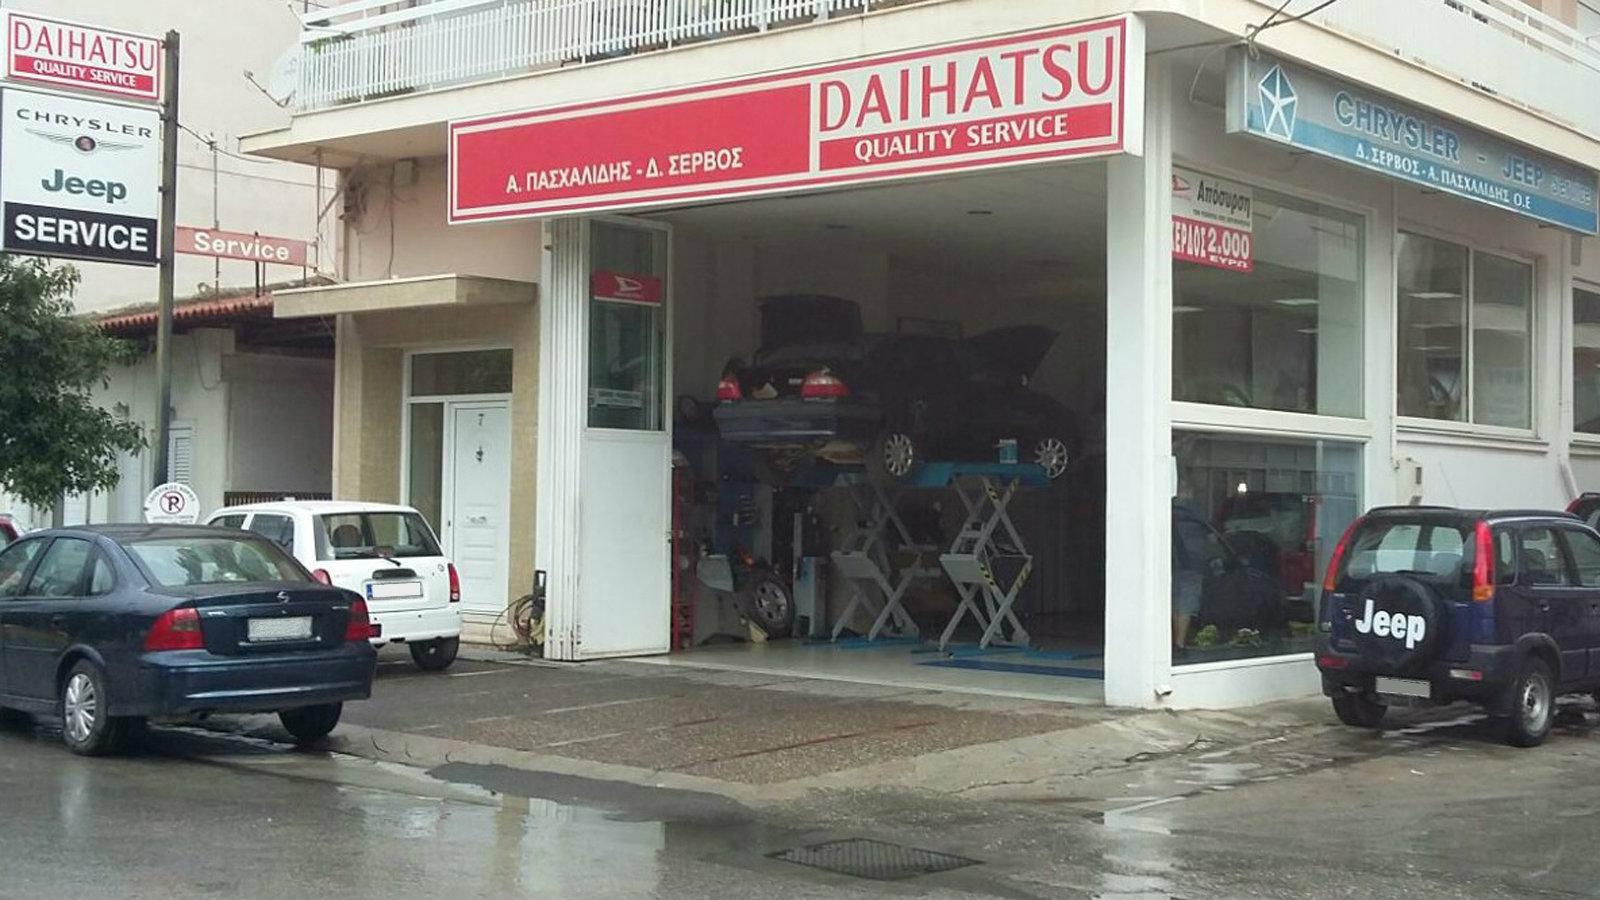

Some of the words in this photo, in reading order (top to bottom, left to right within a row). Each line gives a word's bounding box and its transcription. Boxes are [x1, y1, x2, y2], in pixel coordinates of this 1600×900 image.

[15, 21, 155, 71] DAIHATSU
[33, 59, 86, 79] QUALITY
[90, 69, 136, 87] SERVICE
[819, 36, 1113, 132] DAIHATSU
[16, 108, 151, 138] CHRYSLER
[854, 128, 956, 162] QUALITY
[967, 113, 1068, 147] SERVICE
[1334, 91, 1459, 162] CHRYSLER
[1501, 154, 1543, 190] JEEP
[41, 169, 127, 204] Jeep
[506, 174, 522, 193] Α.
[526, 160, 632, 191] ΠΑΣΧΑΛΙΔΗΣ
[646, 157, 664, 178] Δ.
[668, 147, 743, 176] ΣΕΡΒΟΣ
[1355, 142, 1369, 160] Δ.
[1370, 147, 1420, 175] ΣΕΡΒΟΣ
[1441, 169, 1510, 203] ΠΑΣΧΑΛΙΔΗΣ
[14, 214, 149, 252] SERVICE
[194, 231, 290, 261] Service
[1172, 220, 1206, 258] ΕΡΔΟΣ
[1208, 227, 1249, 260] 2.000
[1355, 599, 1425, 649] Jeep
